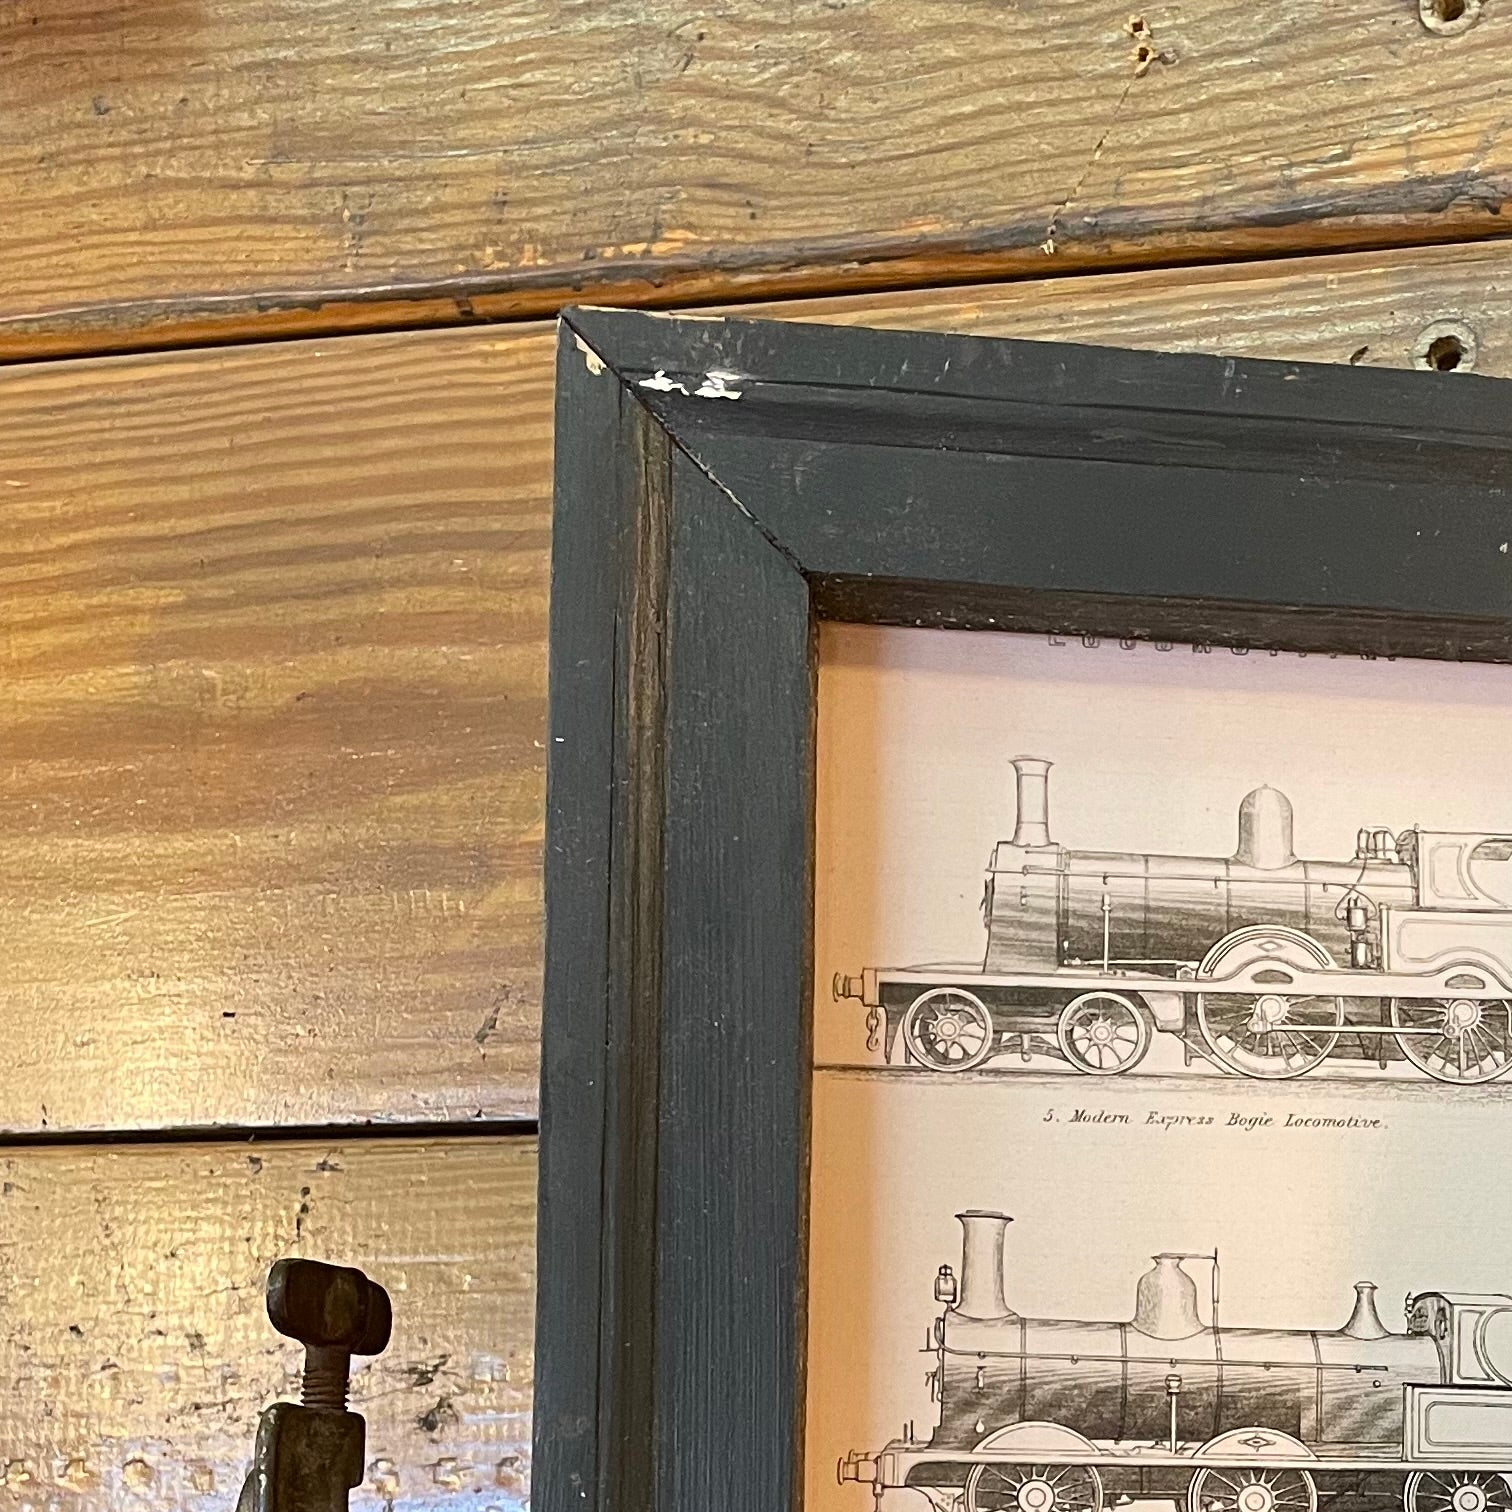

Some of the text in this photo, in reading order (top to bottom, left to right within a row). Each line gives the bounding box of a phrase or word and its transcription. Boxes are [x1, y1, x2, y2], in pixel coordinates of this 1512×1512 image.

[1068, 1109, 1130, 1125] Modern
[1145, 1110, 1215, 1132] Express
[1224, 1111, 1274, 1131] Bogie
